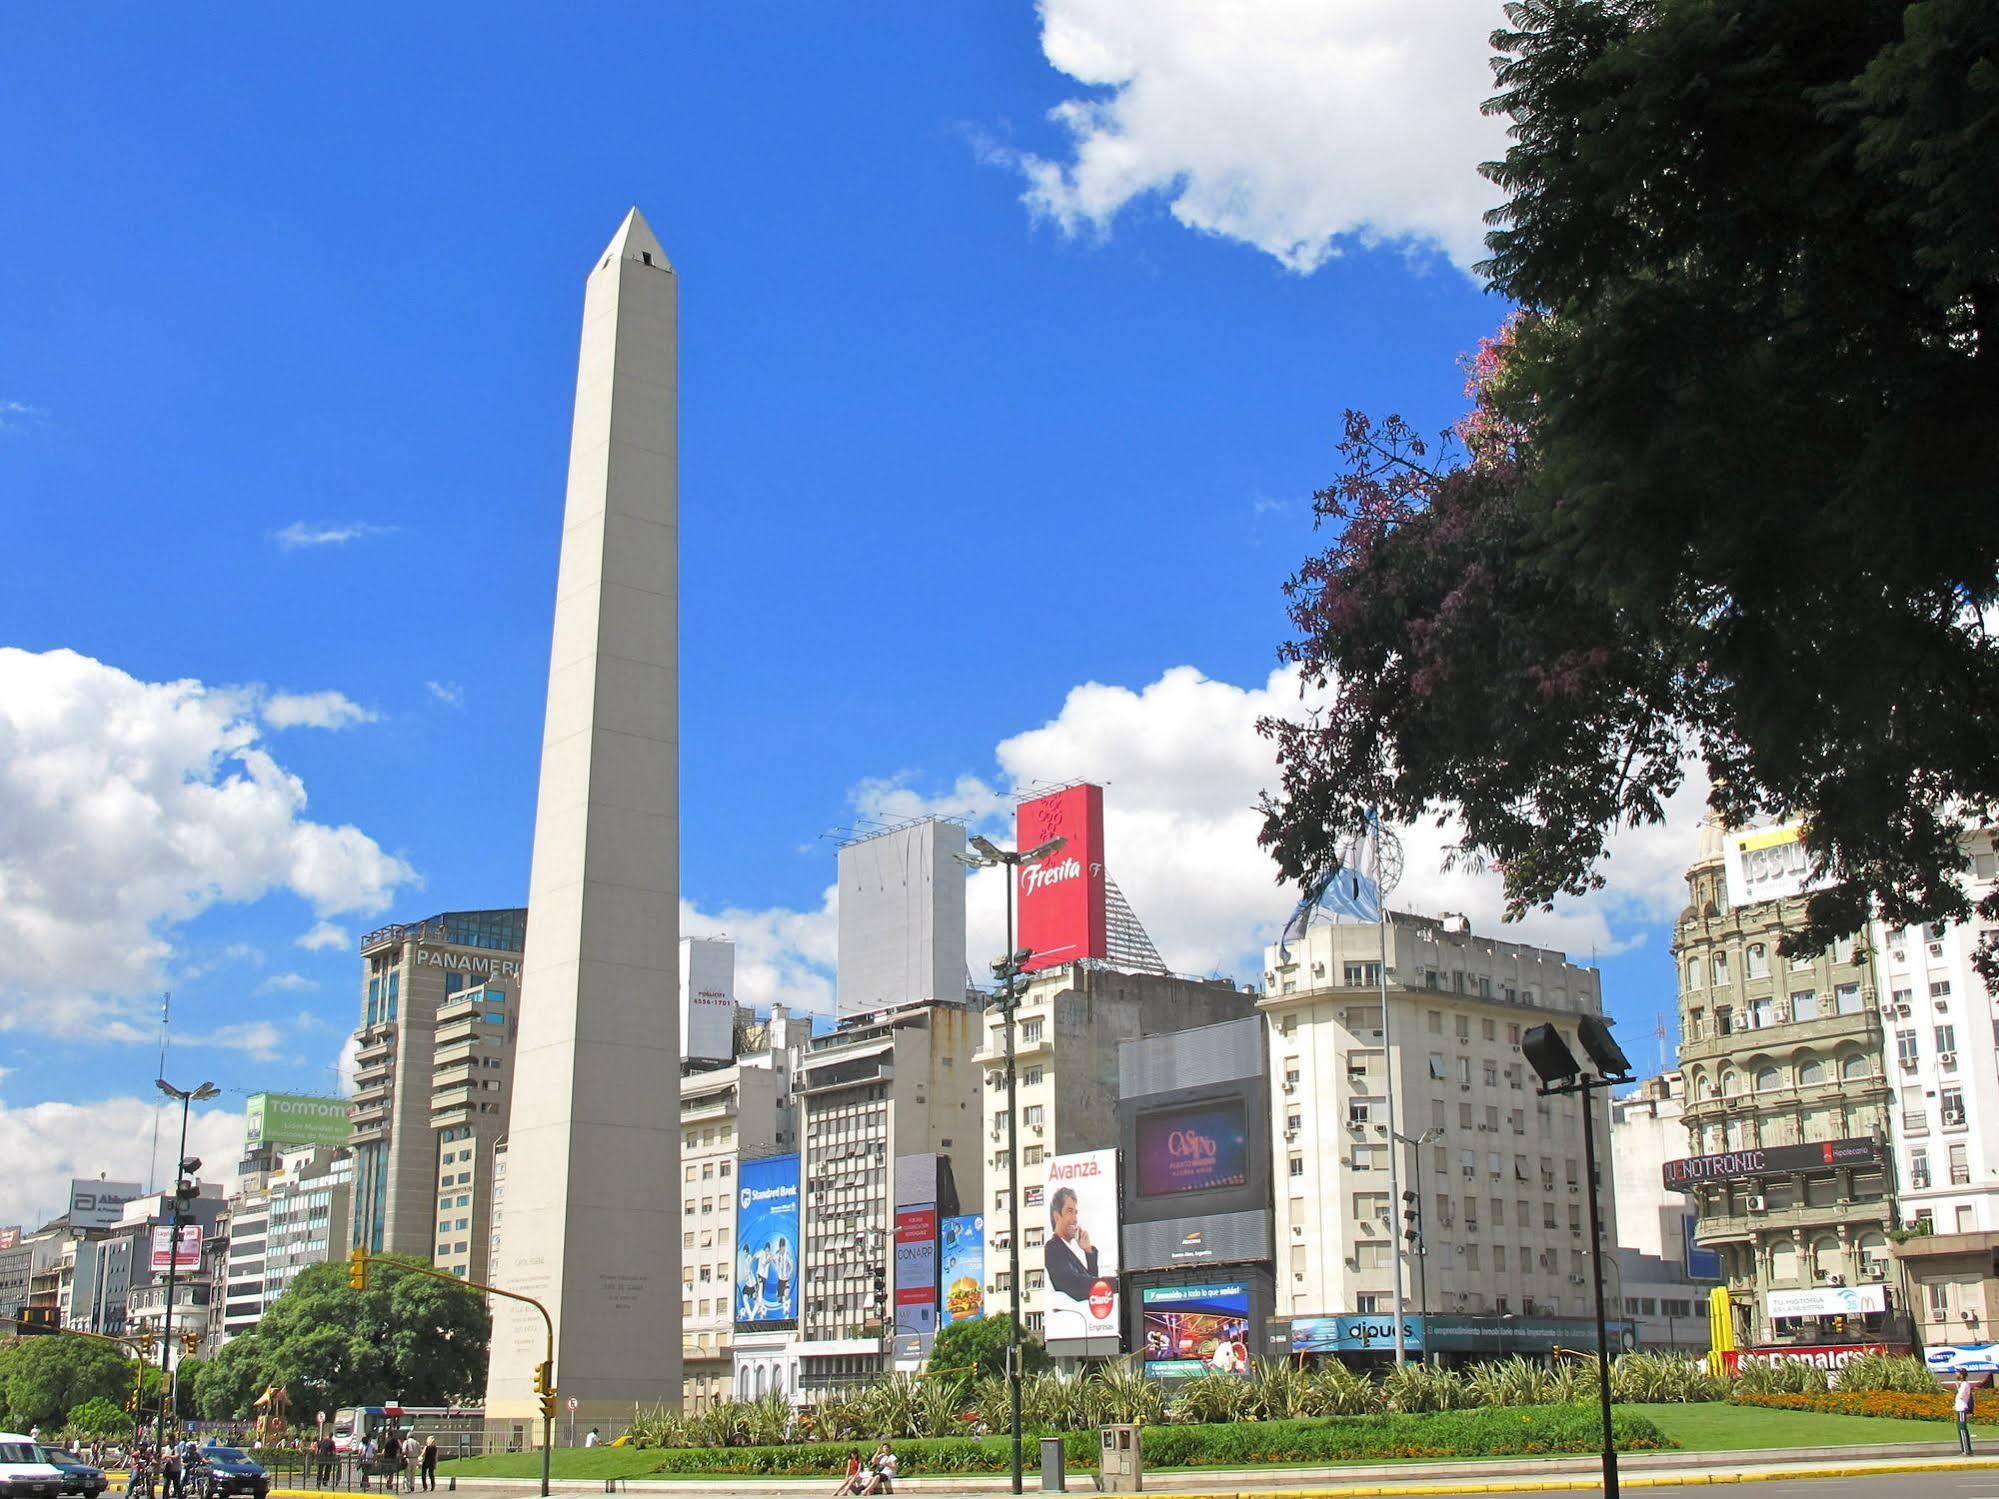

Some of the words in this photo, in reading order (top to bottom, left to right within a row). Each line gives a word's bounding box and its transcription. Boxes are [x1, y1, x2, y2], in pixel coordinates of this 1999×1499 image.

[1022, 857, 1080, 896] Fresita
[1089, 862, 1101, 877] F
[752, 1186, 780, 1200] Standard
[780, 1184, 798, 1197] Bank
[1201, 1288, 1207, 1296] lo
[1207, 1288, 1219, 1298] que
[1350, 1321, 1413, 1338] diqus
[188, 1423, 194, 1431] E
